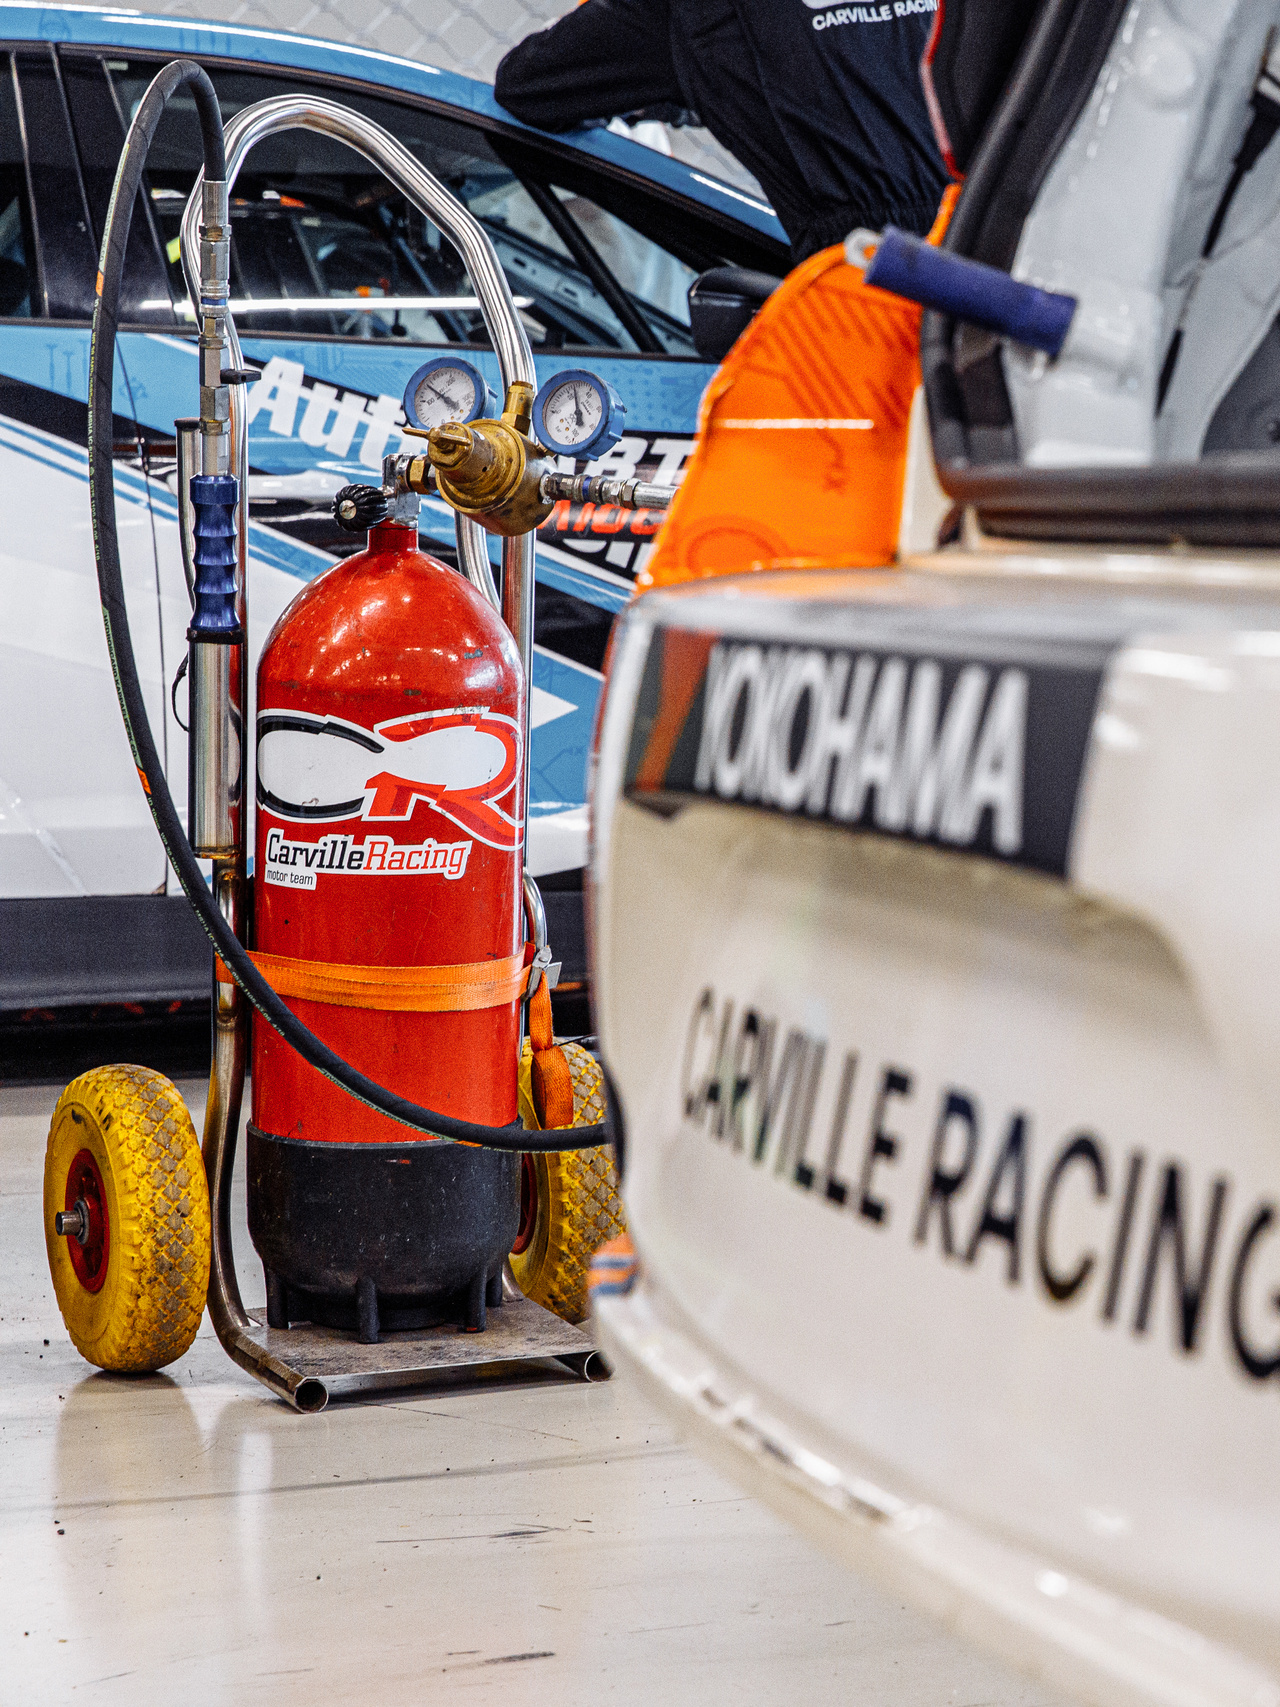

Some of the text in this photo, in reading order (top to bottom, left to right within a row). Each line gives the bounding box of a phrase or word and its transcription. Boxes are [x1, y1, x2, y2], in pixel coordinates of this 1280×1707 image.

[812, 0, 940, 31] CARVILLE RACIN
[695, 643, 1029, 855] YOKOHAMA
[267, 869, 314, 886] motor team
[682, 987, 914, 1226] CARVILLE
